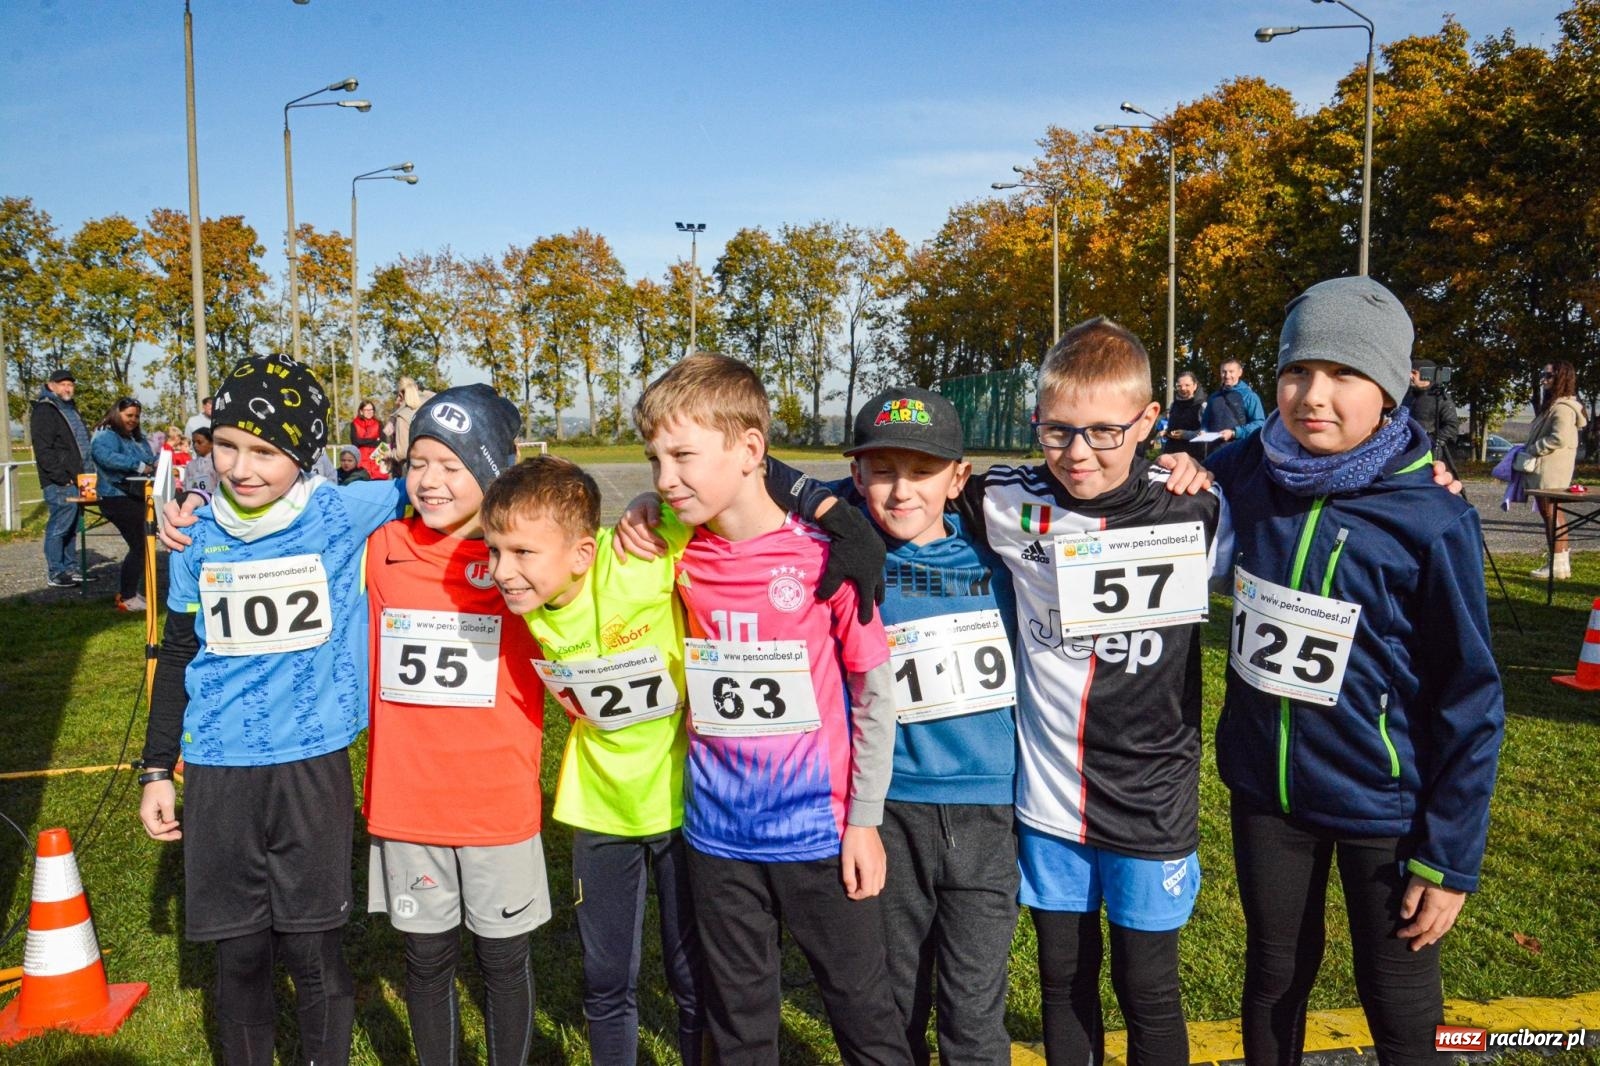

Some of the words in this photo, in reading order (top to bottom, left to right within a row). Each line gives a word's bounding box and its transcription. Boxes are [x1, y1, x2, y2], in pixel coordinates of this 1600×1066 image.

[883, 398, 924, 411] SUPER
[437, 405, 466, 429] JR
[874, 408, 930, 426] MARIO
[480, 445, 500, 478] JUNIOR
[1108, 533, 1199, 550] www.personalbest.pl
[1021, 552, 1050, 564] adidas
[238, 565, 317, 580] www.personalbest.pl
[1092, 563, 1175, 614] 57
[211, 590, 323, 638] 102
[1260, 593, 1351, 625] www.personalbest.pl
[416, 621, 496, 634] www.personalbest.pl
[557, 640, 592, 655] ZSOMS
[723, 651, 803, 662] www.personalbest.pl
[1236, 610, 1338, 684] 125
[398, 644, 468, 688] 55
[577, 655, 658, 675] www.personalbest.pl
[895, 646, 1007, 703] 119
[558, 675, 663, 717] 127
[712, 676, 786, 720] 63
